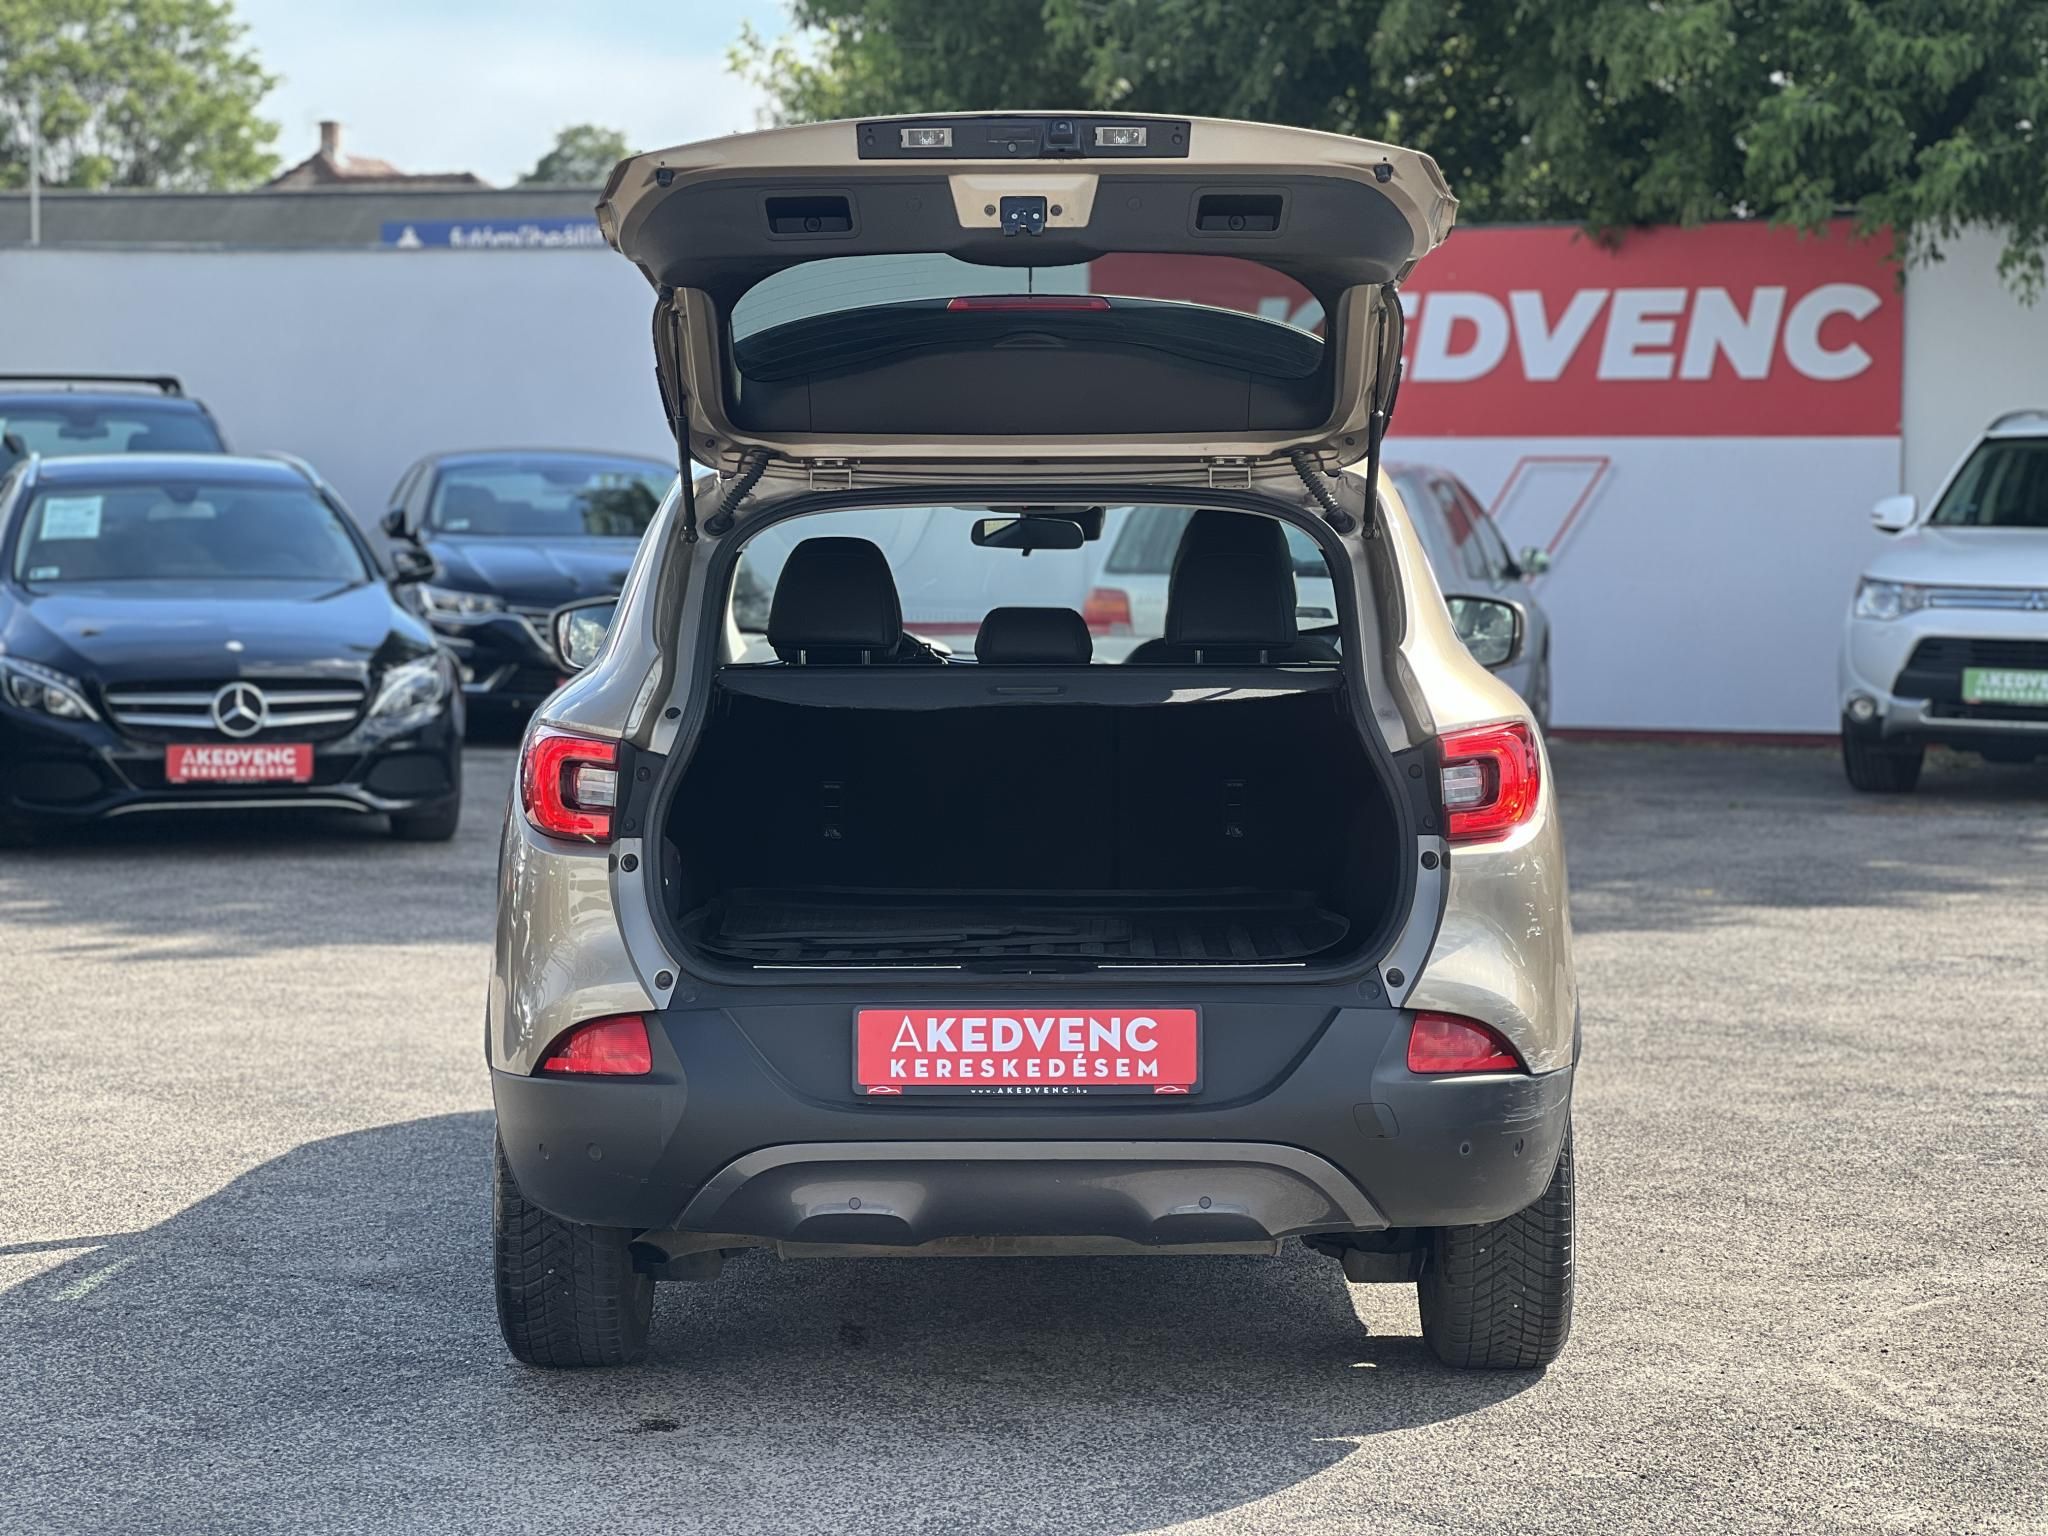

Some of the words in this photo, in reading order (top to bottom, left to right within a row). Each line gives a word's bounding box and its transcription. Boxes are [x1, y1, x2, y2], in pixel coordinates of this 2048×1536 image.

[1255, 282, 1882, 381] DVENC
[181, 748, 297, 766] AKEDVENC
[891, 1015, 1158, 1052] AKEDVENC
[891, 1053, 1158, 1078] KERESKEDÉSEM
[970, 1086, 1087, 1094] www.AKEDVENC.hu
